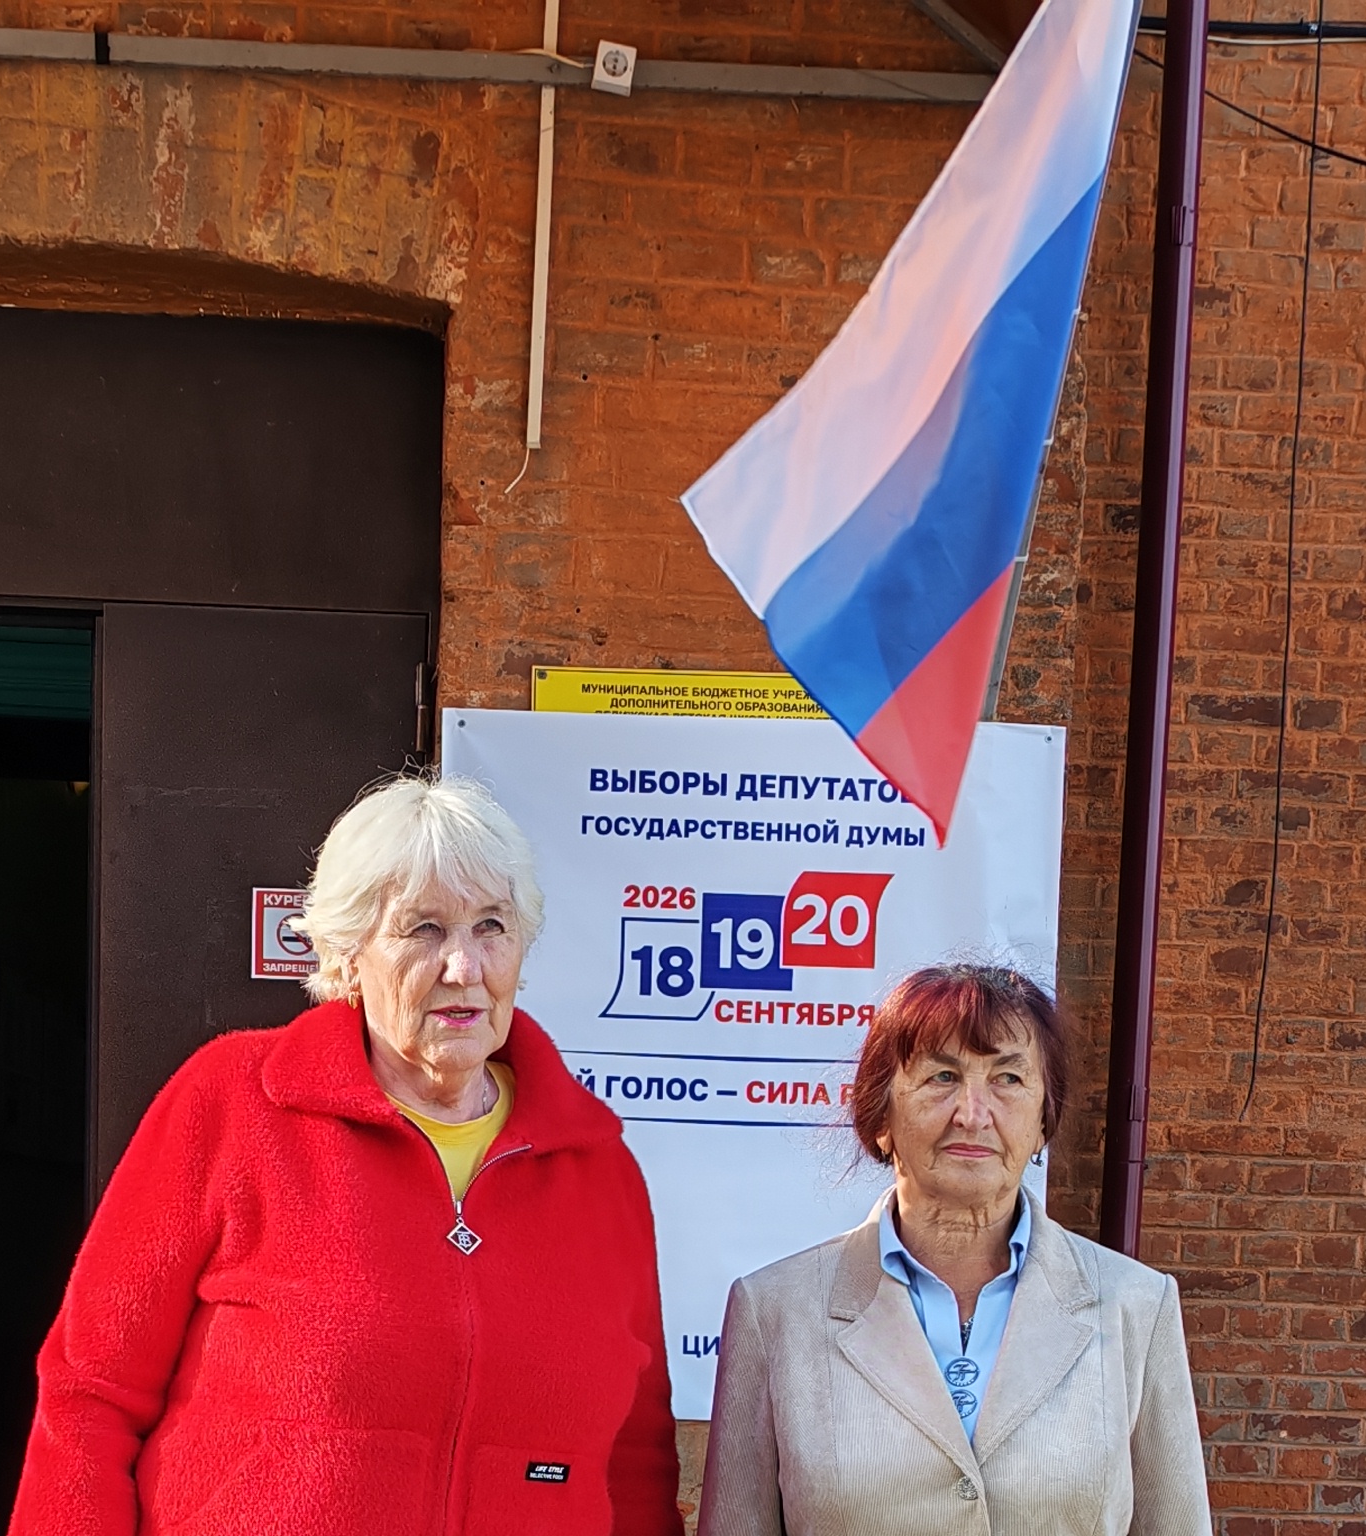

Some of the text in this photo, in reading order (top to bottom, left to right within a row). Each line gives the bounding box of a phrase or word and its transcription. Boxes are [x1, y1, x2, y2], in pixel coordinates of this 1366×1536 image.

[581, 683, 689, 697] МУНИЦИПАЛЬНОЕ
[692, 687, 769, 700] БЮДЖЕТНОЕ
[610, 698, 824, 714] ДОПОЛНИТЕЛЬНОГО ОБРАЗОВАНИЯ
[589, 768, 913, 803] ВЫБОРЫ ДЕПУТАТО
[581, 815, 925, 848] ГОСУДАРСТВЕННОЙ ДУМЫ
[623, 884, 696, 909] 2026
[631, 893, 870, 997] 18 19 20
[714, 999, 875, 1027] СЕНТЯБРЯ
[605, 1075, 709, 1102] ГОЛОС
[746, 1080, 831, 1105] СИЛА
